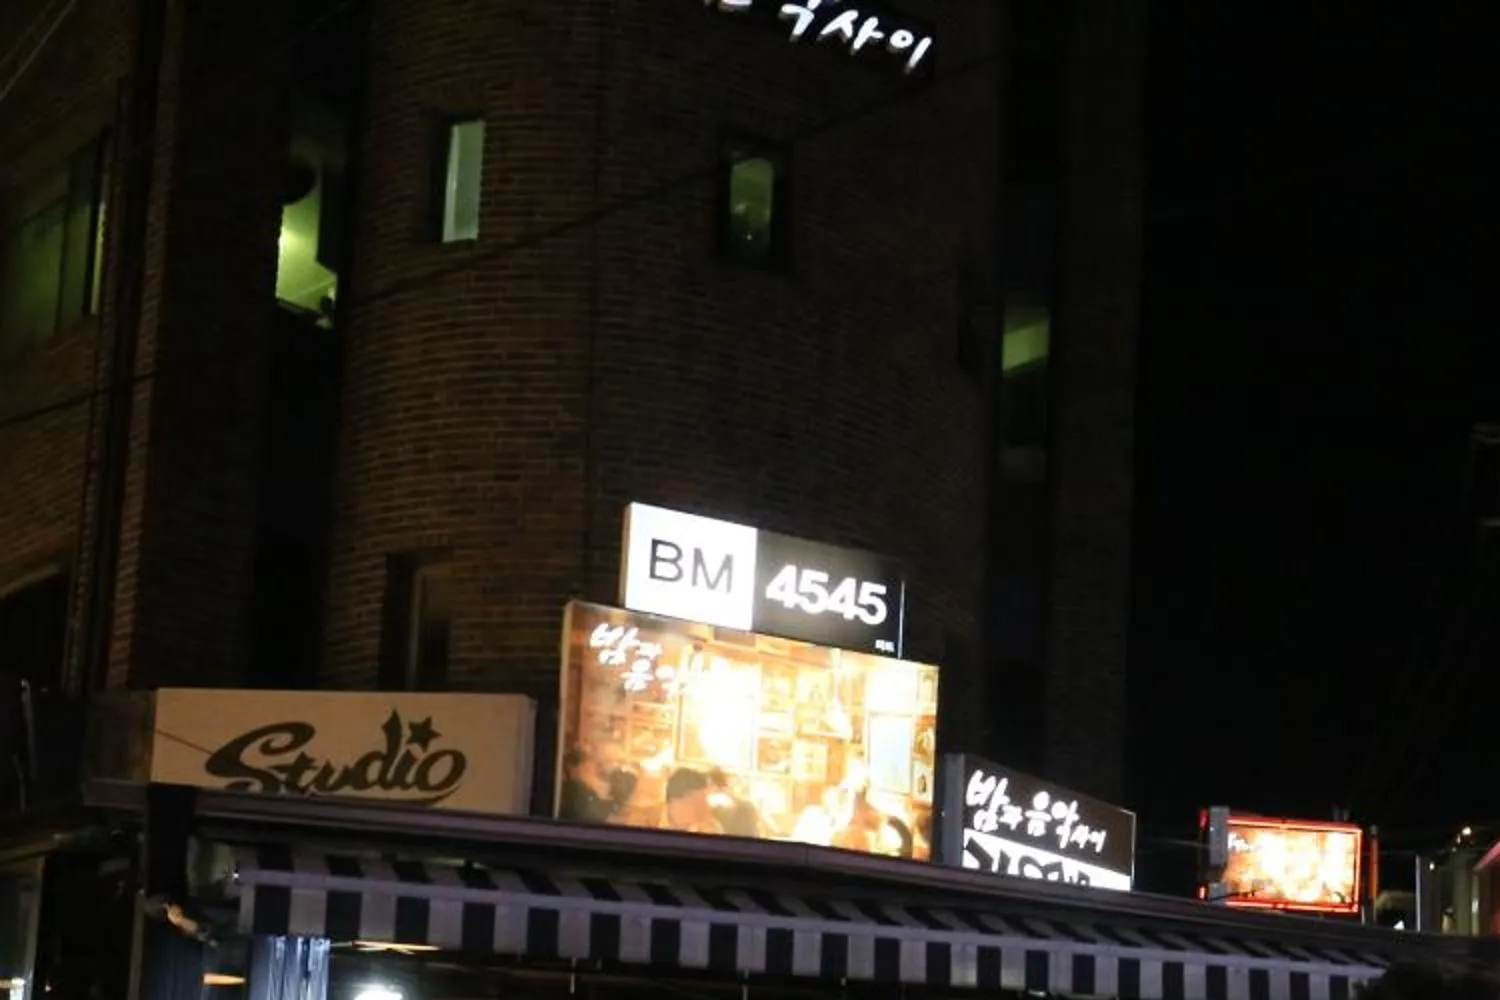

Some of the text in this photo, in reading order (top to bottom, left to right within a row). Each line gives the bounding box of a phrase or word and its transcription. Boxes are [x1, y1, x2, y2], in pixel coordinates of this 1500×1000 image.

[649, 538, 888, 626] BM 4545
[204, 706, 468, 798] Studio
